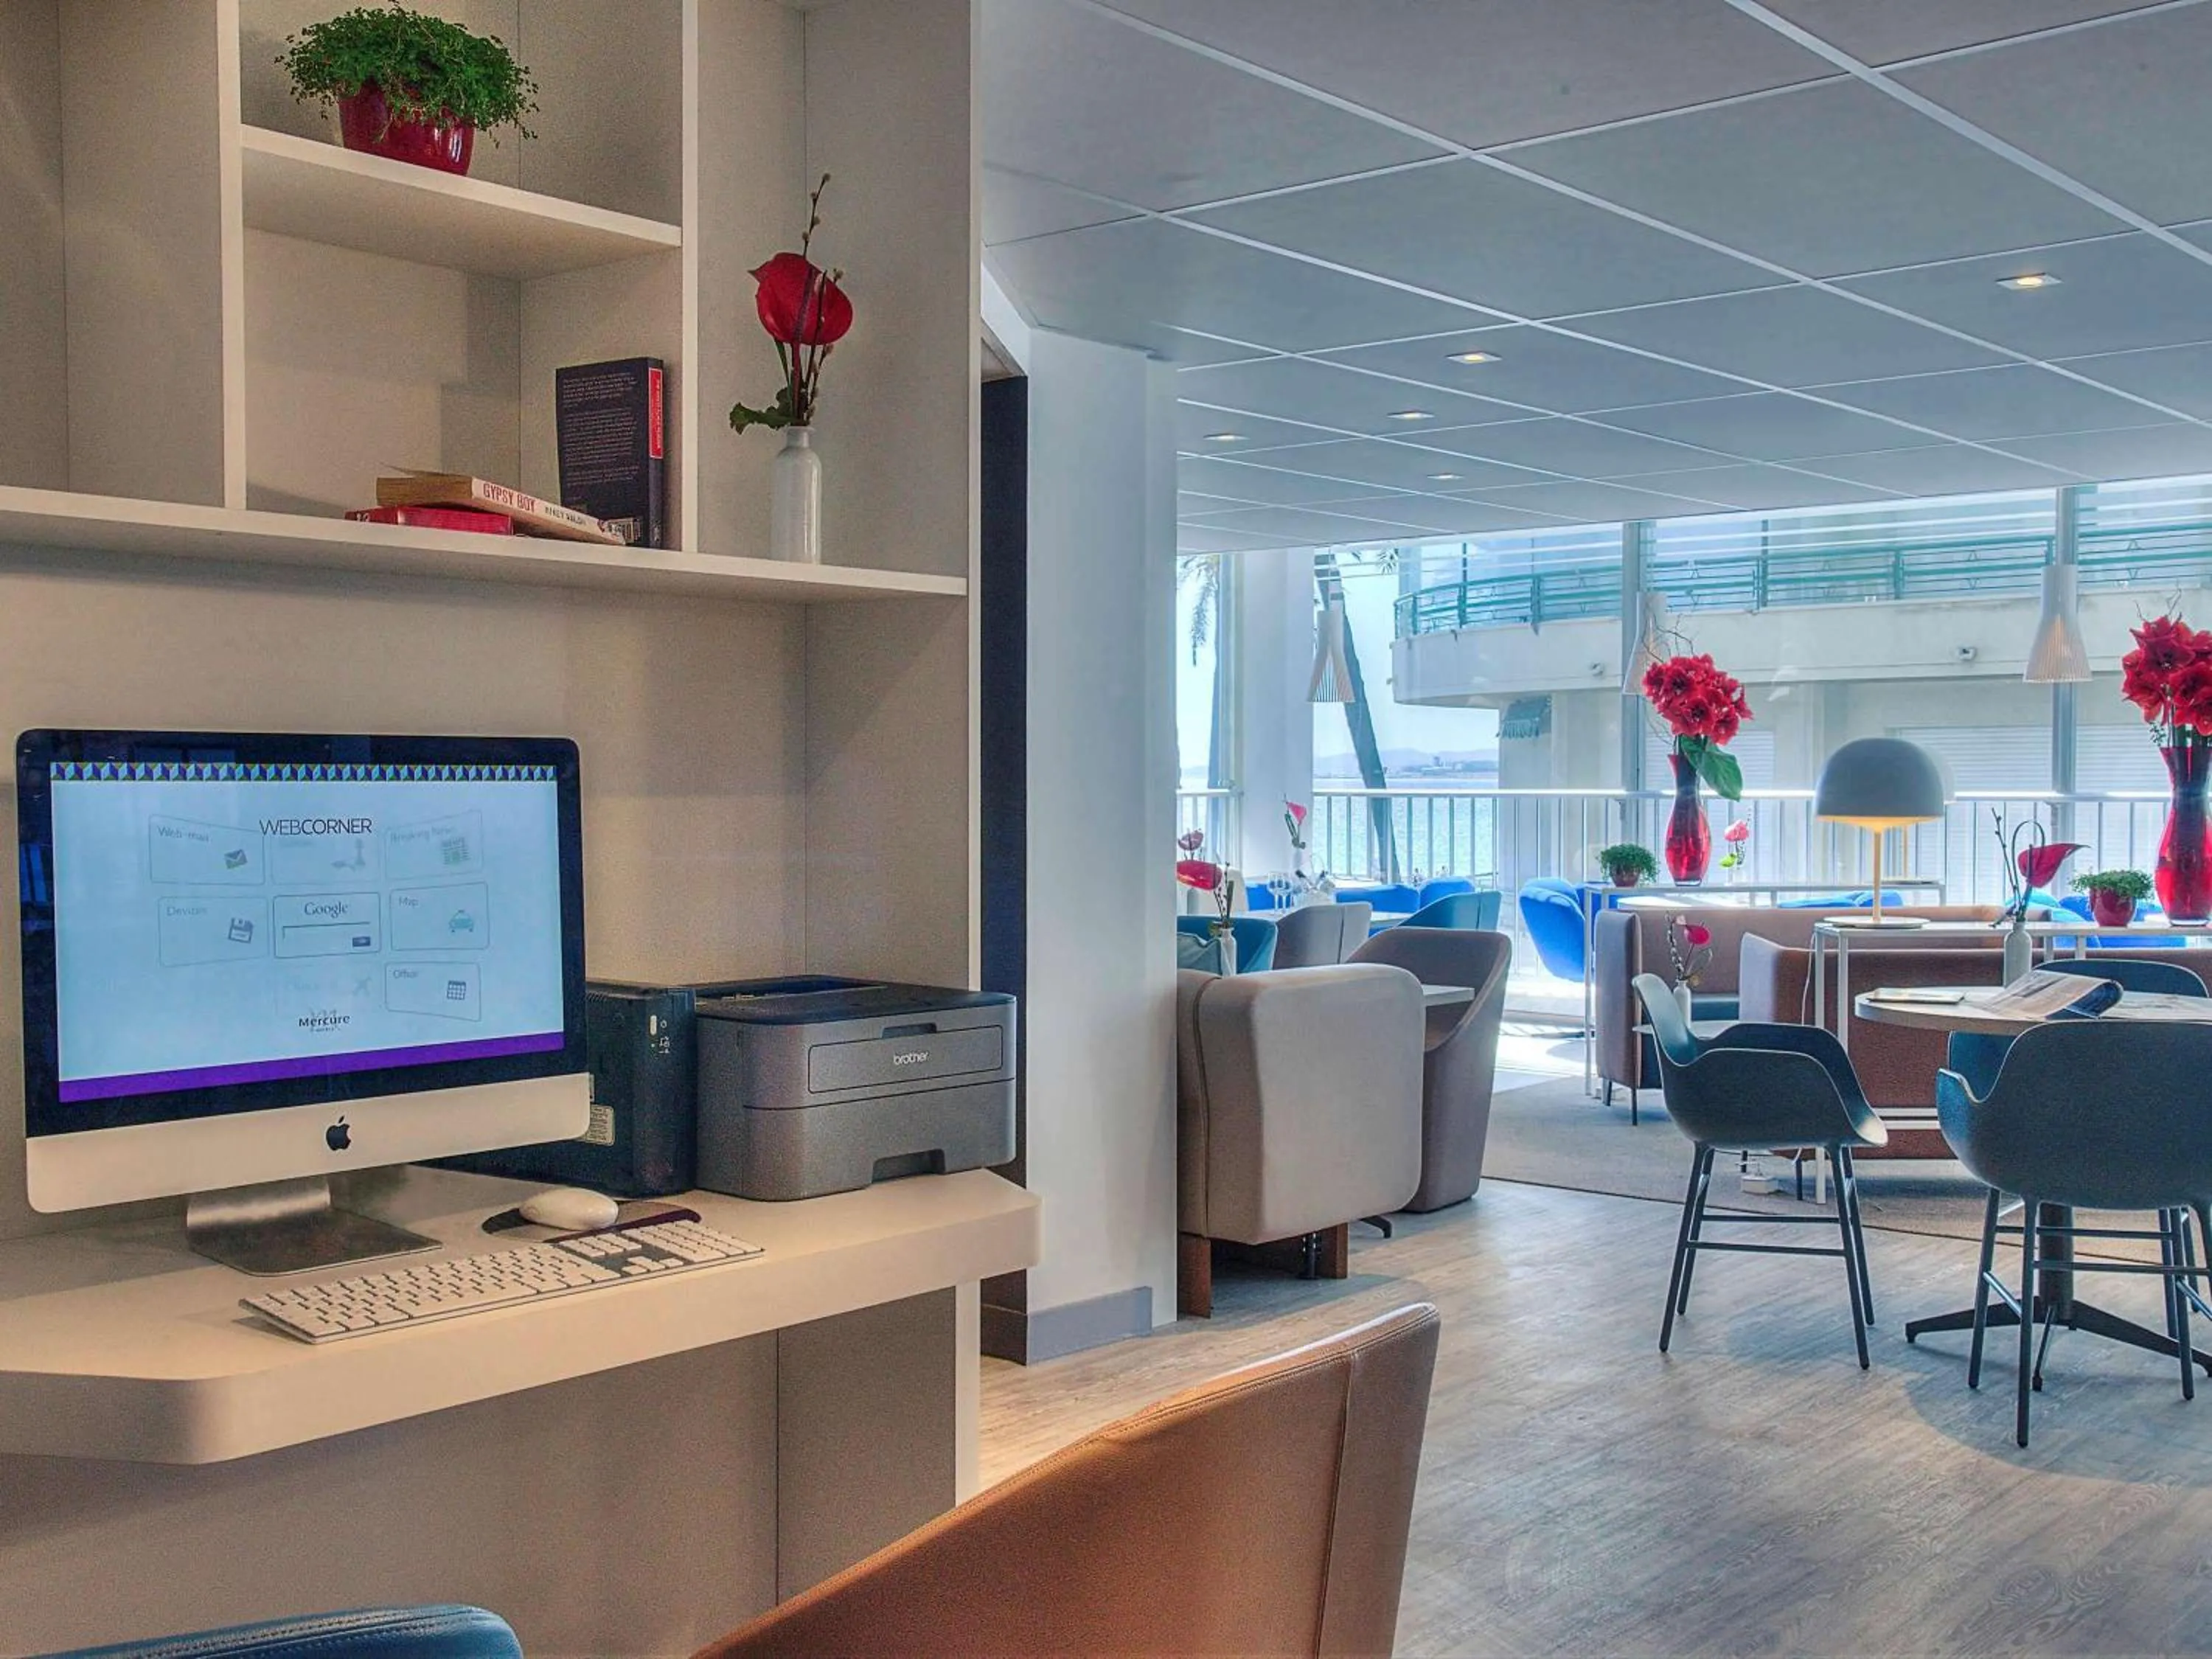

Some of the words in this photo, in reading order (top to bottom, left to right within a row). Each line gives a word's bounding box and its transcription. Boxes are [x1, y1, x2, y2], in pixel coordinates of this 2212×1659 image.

[483, 483, 513, 507] GYPSY
[517, 493, 535, 514] BOY
[260, 818, 372, 835] WEBCORNER
[304, 900, 349, 919] Google
[298, 1014, 351, 1027] Mercure
[894, 1051, 928, 1065] brother
